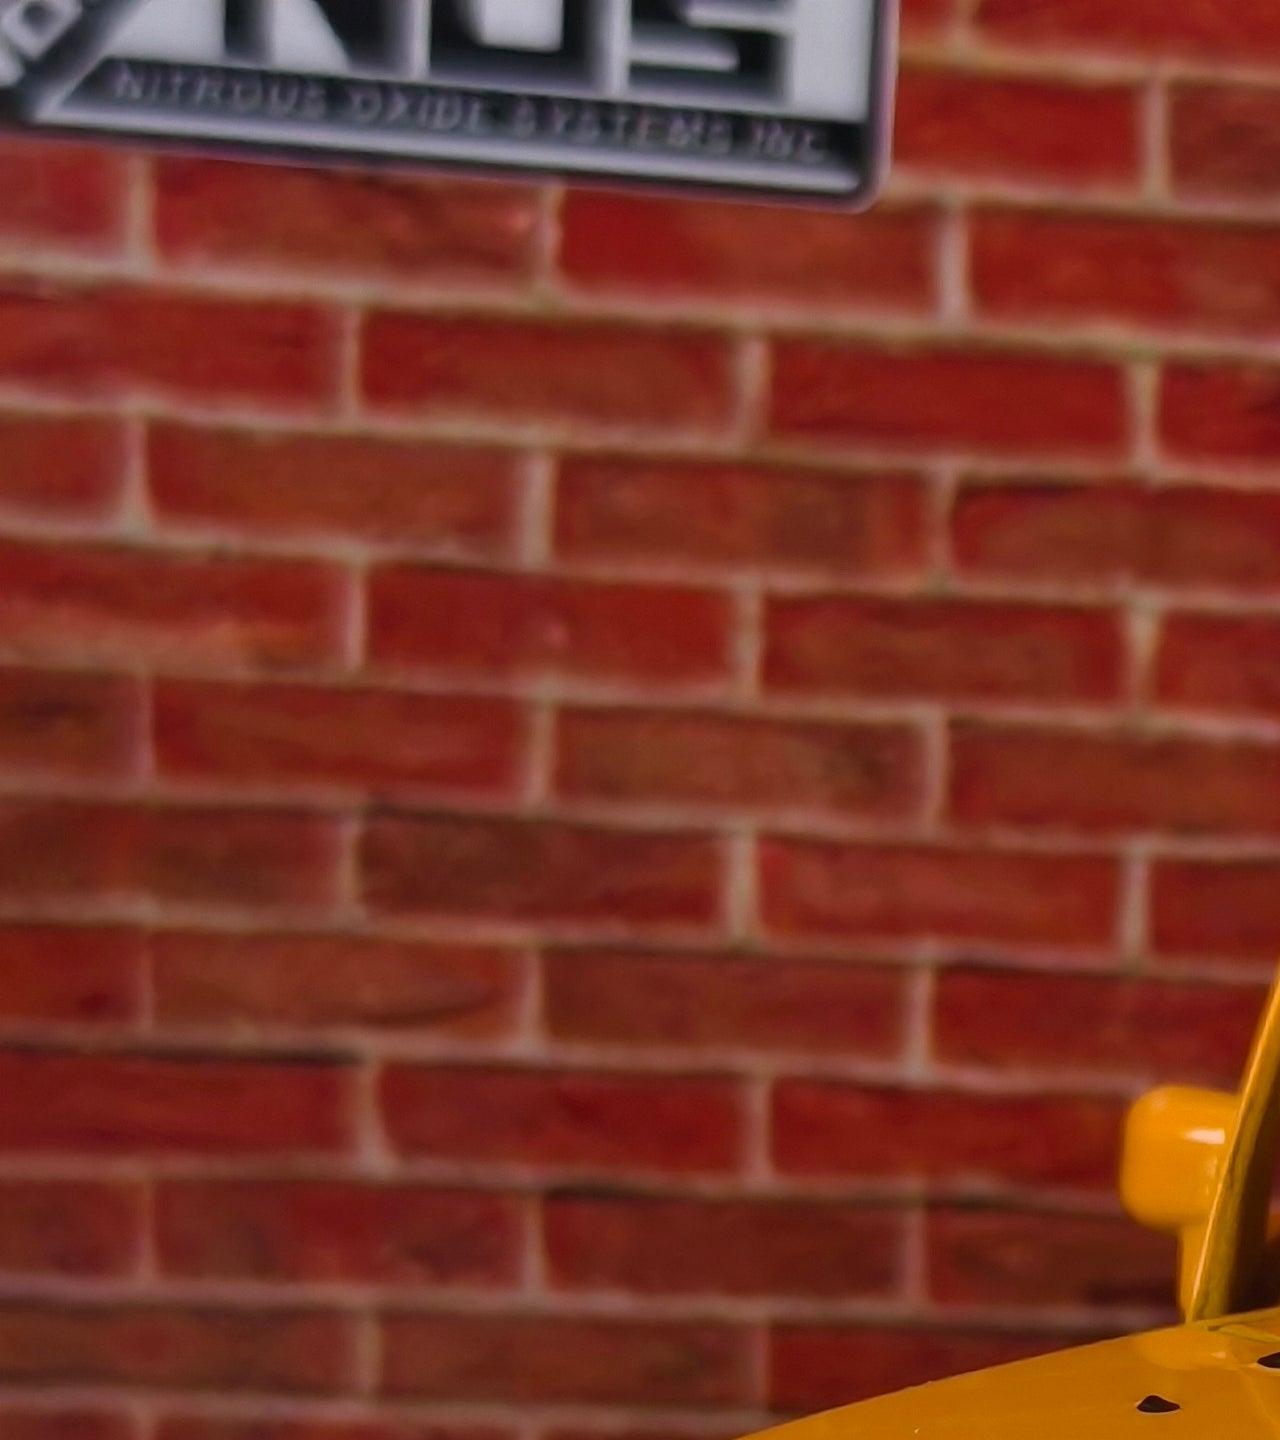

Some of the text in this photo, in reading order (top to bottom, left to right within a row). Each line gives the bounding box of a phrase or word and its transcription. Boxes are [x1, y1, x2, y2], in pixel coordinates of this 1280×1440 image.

[113, 62, 327, 121] NITROUS
[350, 84, 492, 137] OXIDE
[512, 98, 732, 156] SYSTEMS
